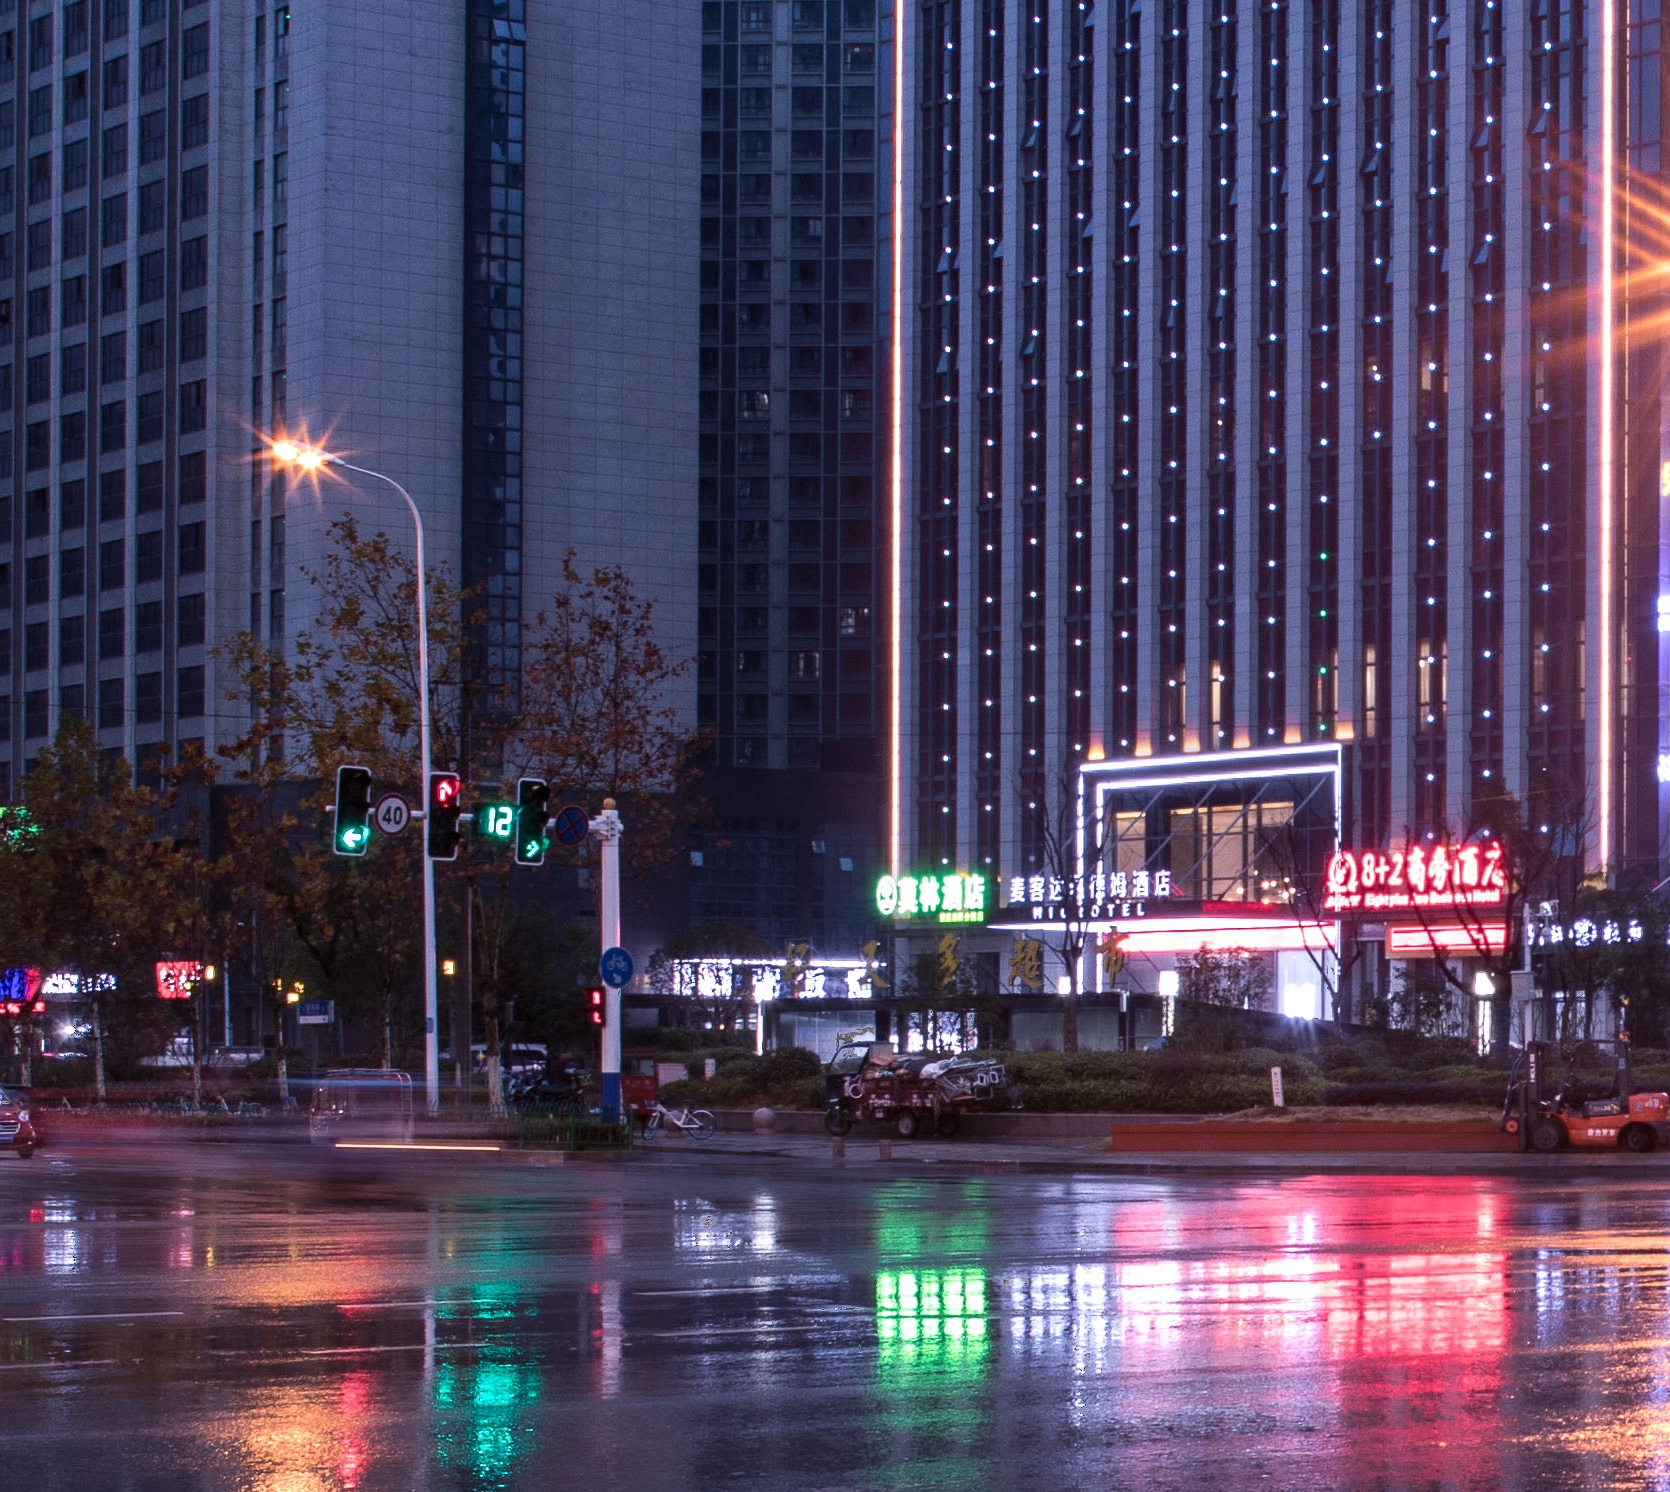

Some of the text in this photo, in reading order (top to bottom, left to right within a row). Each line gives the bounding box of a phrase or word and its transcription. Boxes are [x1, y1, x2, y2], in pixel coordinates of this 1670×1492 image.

[382, 805, 404, 828] 40
[487, 806, 513, 836] 12
[897, 873, 986, 914] 莫林酒店
